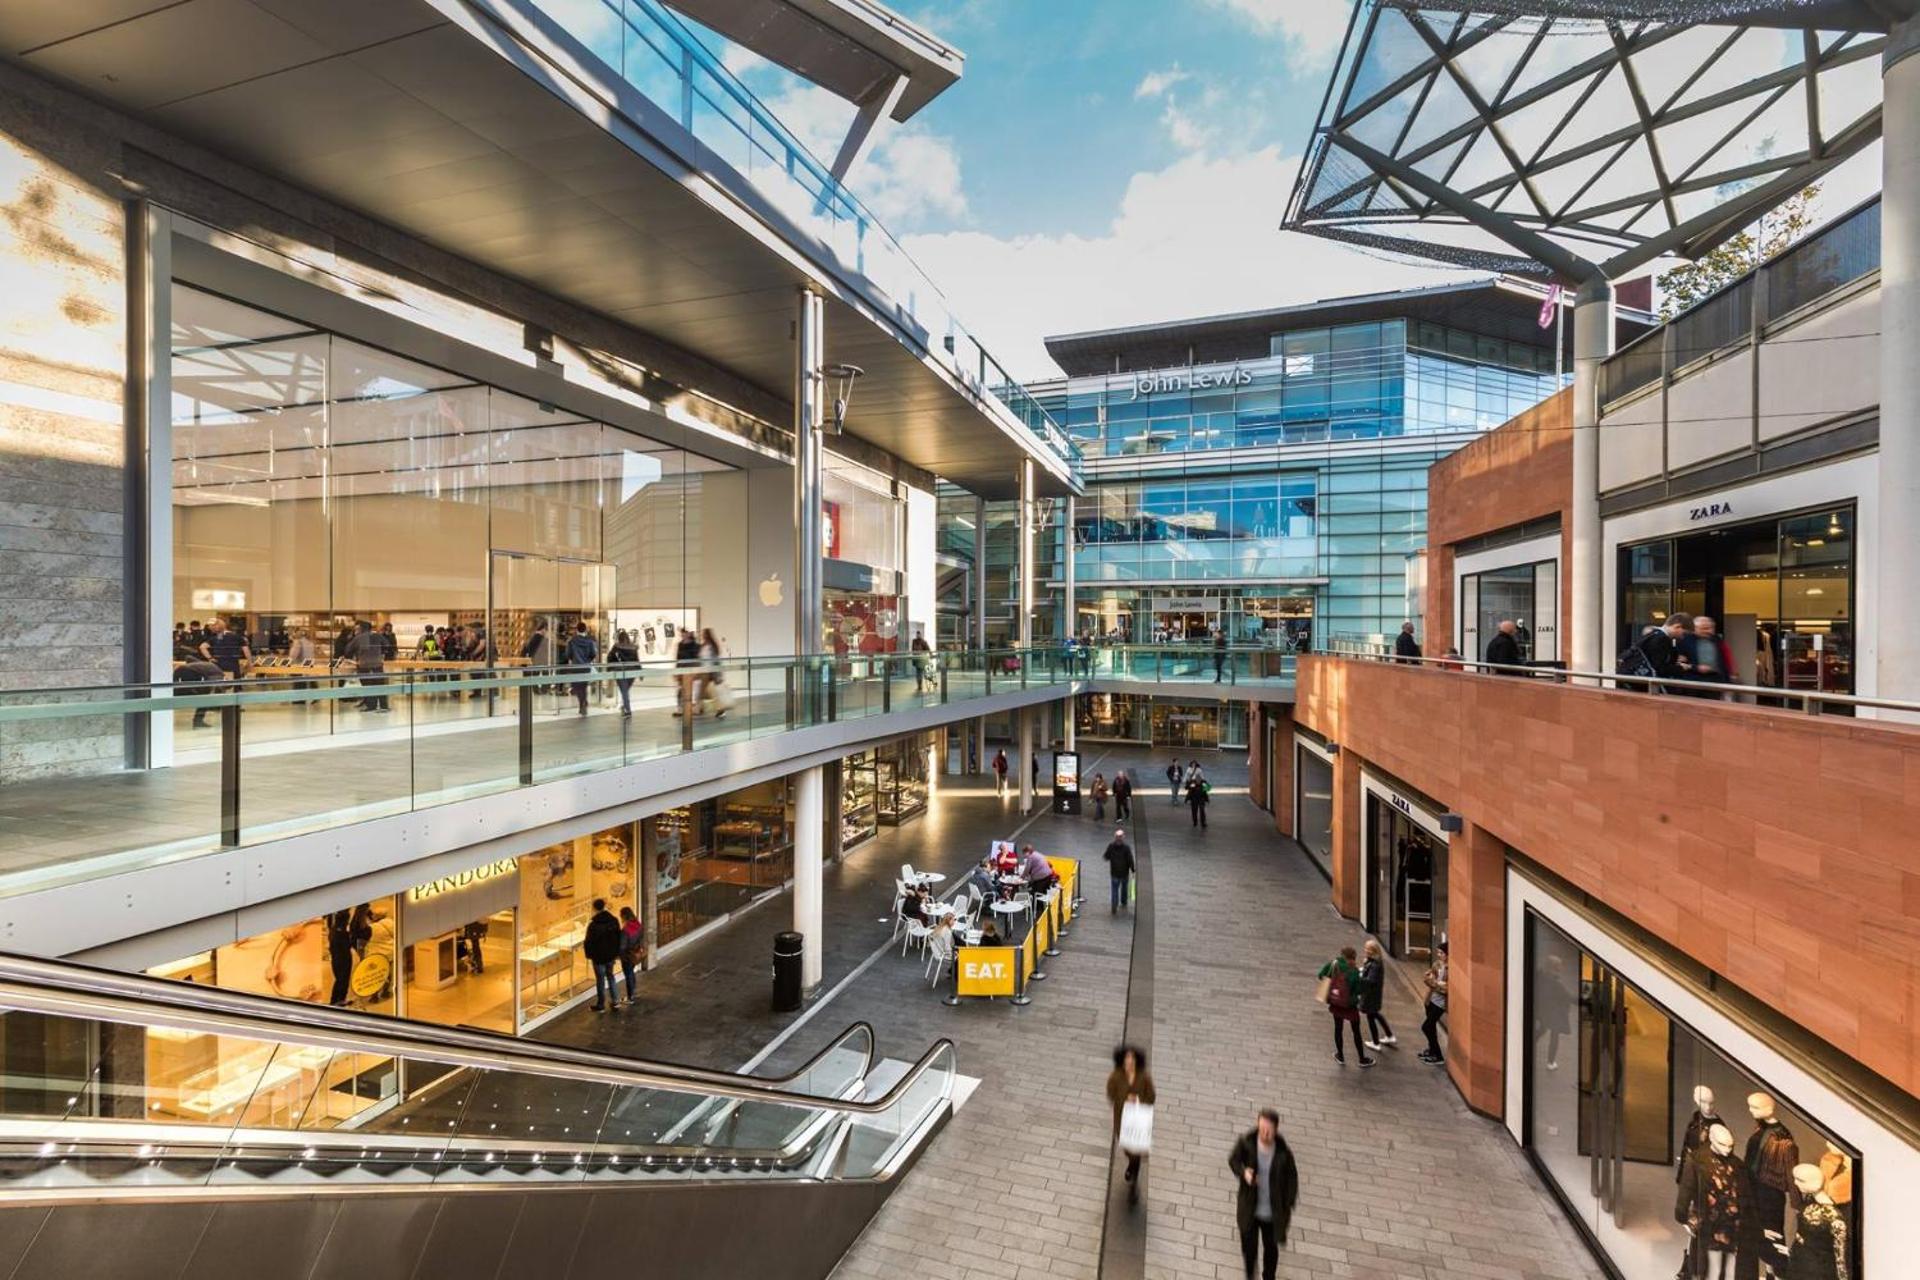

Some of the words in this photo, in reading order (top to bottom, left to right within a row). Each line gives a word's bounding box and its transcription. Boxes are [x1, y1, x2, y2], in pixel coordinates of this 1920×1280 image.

[1130, 373, 1182, 401] John
[1188, 366, 1253, 389] Lewis
[1689, 502, 1733, 520] ZARA
[1537, 625, 1555, 633] ZARA
[1391, 793, 1411, 815] ZARA
[414, 857, 518, 900] PANDORA
[964, 961, 1009, 979] EAT.
